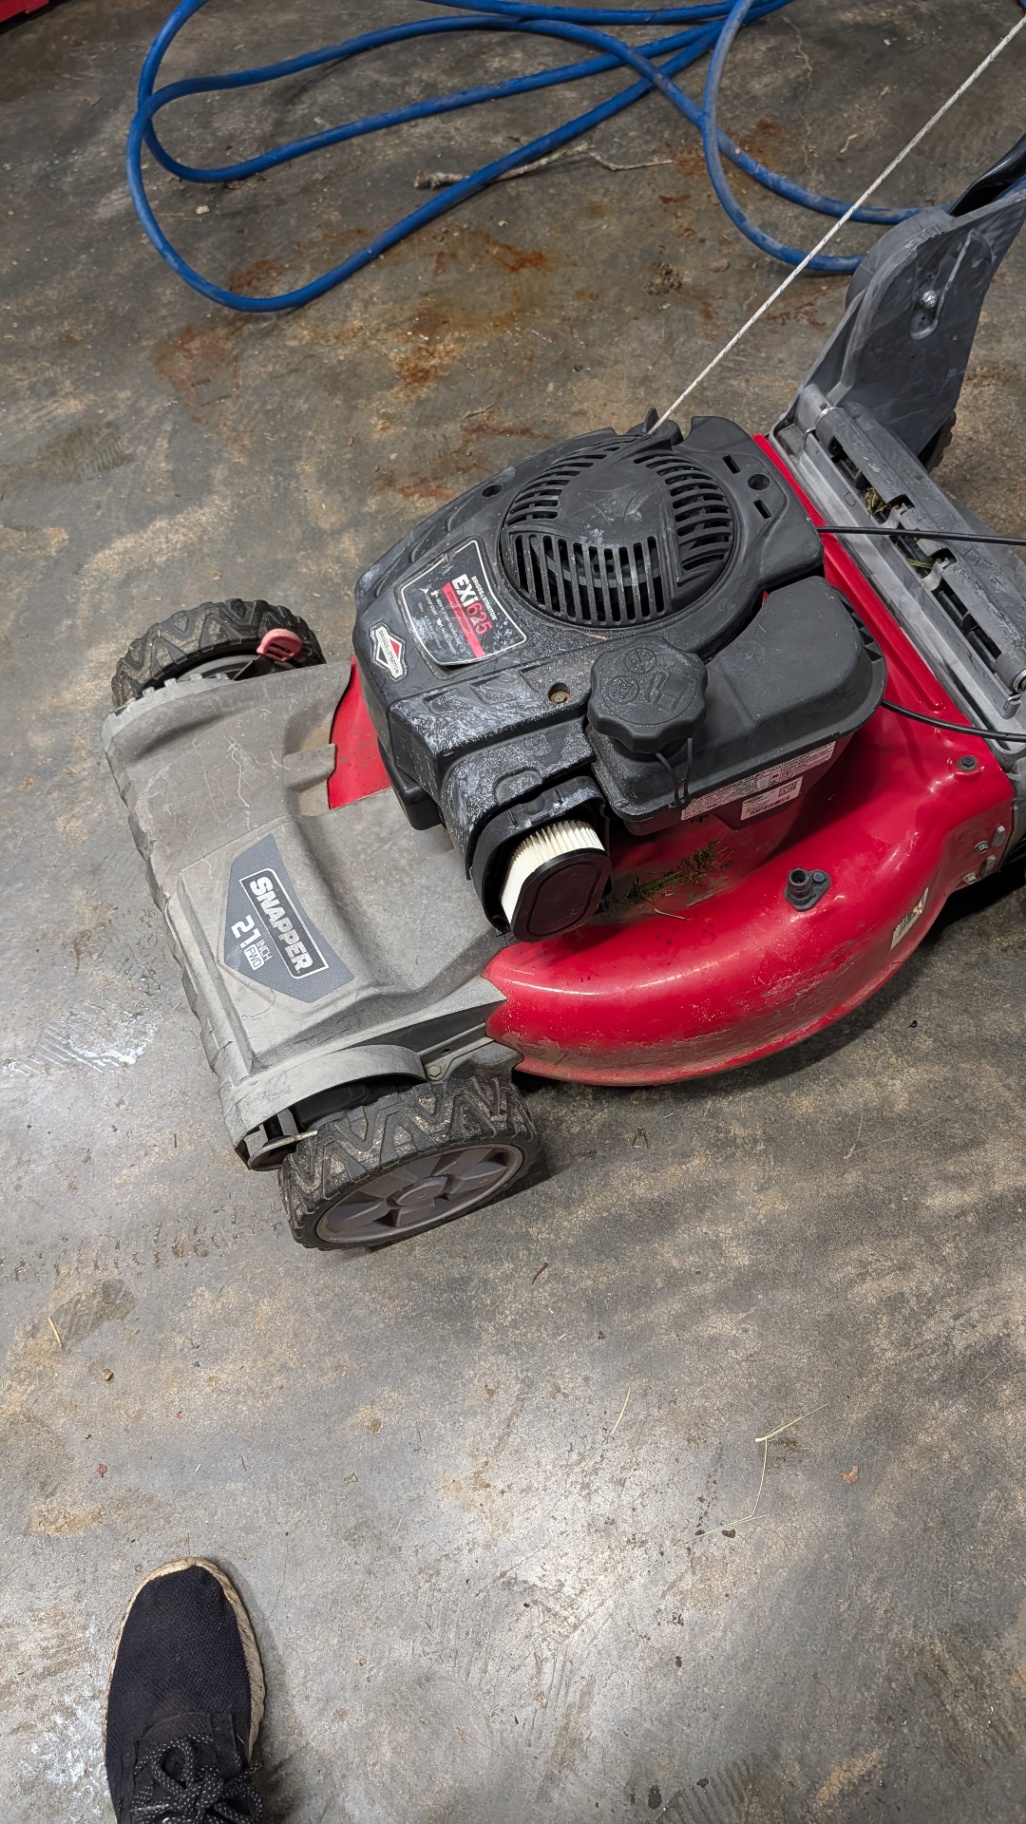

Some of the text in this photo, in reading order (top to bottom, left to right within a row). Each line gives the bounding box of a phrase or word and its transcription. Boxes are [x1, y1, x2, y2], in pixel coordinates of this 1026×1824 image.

[231, 914, 272, 962] 21 INCH
[250, 877, 313, 971] SNAPPER
[245, 948, 263, 968] FWD
